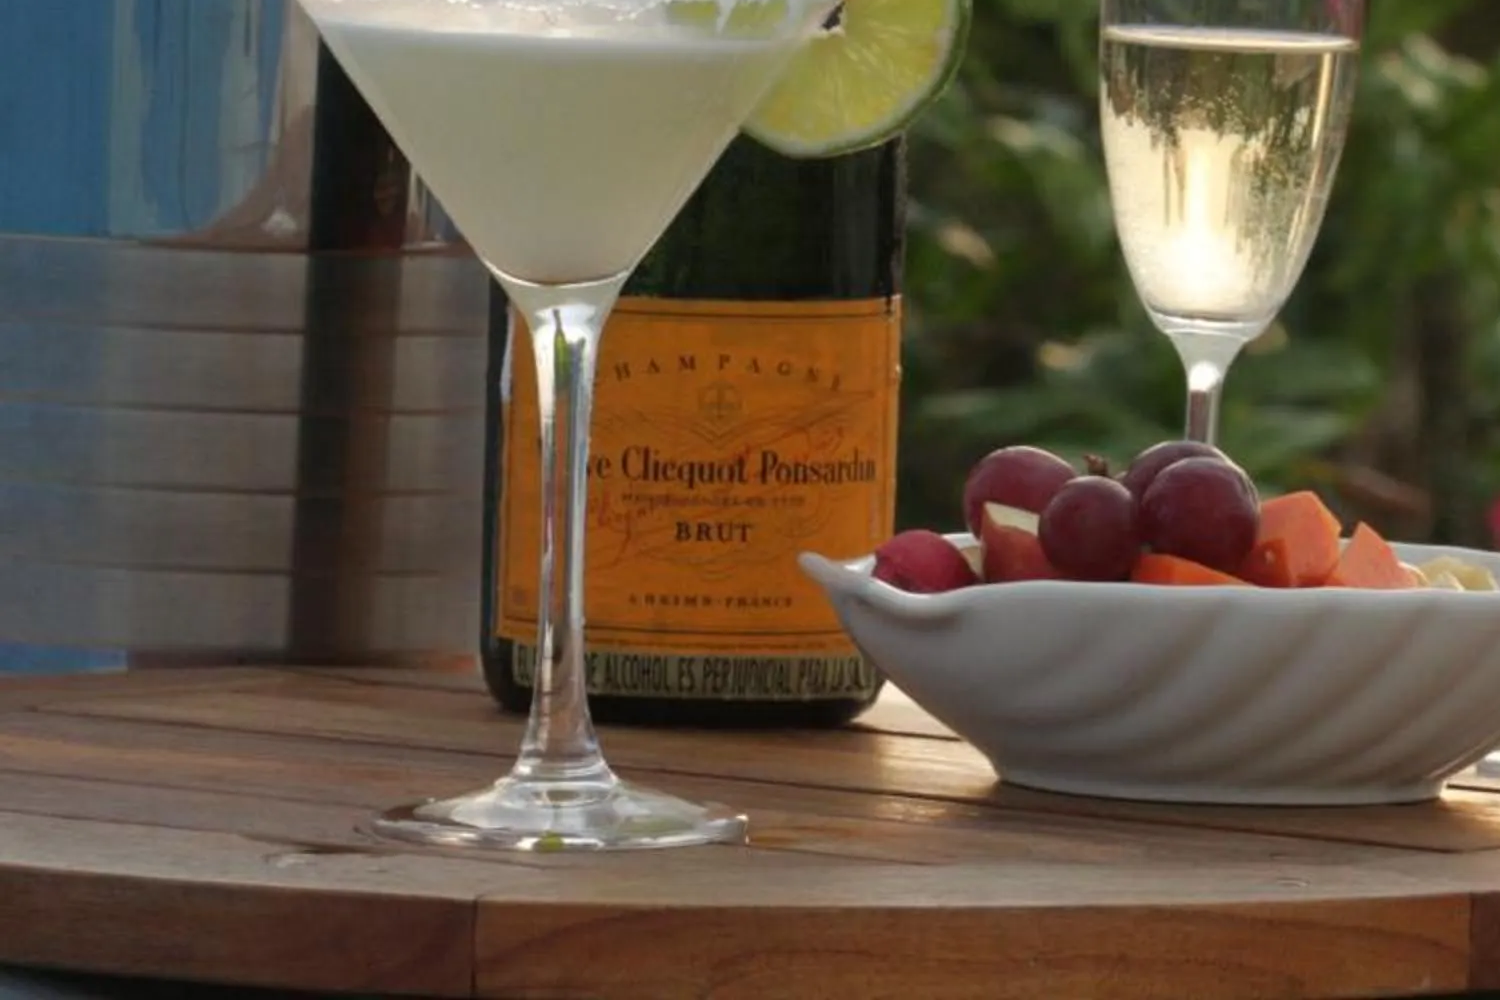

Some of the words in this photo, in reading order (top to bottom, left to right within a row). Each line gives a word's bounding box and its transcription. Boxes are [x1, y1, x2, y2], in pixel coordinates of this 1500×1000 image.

[621, 445, 748, 490] Clicquot
[760, 447, 876, 486] Ponsardin
[674, 520, 755, 543] BRUT
[604, 652, 670, 691] ALCOHOL
[677, 656, 696, 693] ES
